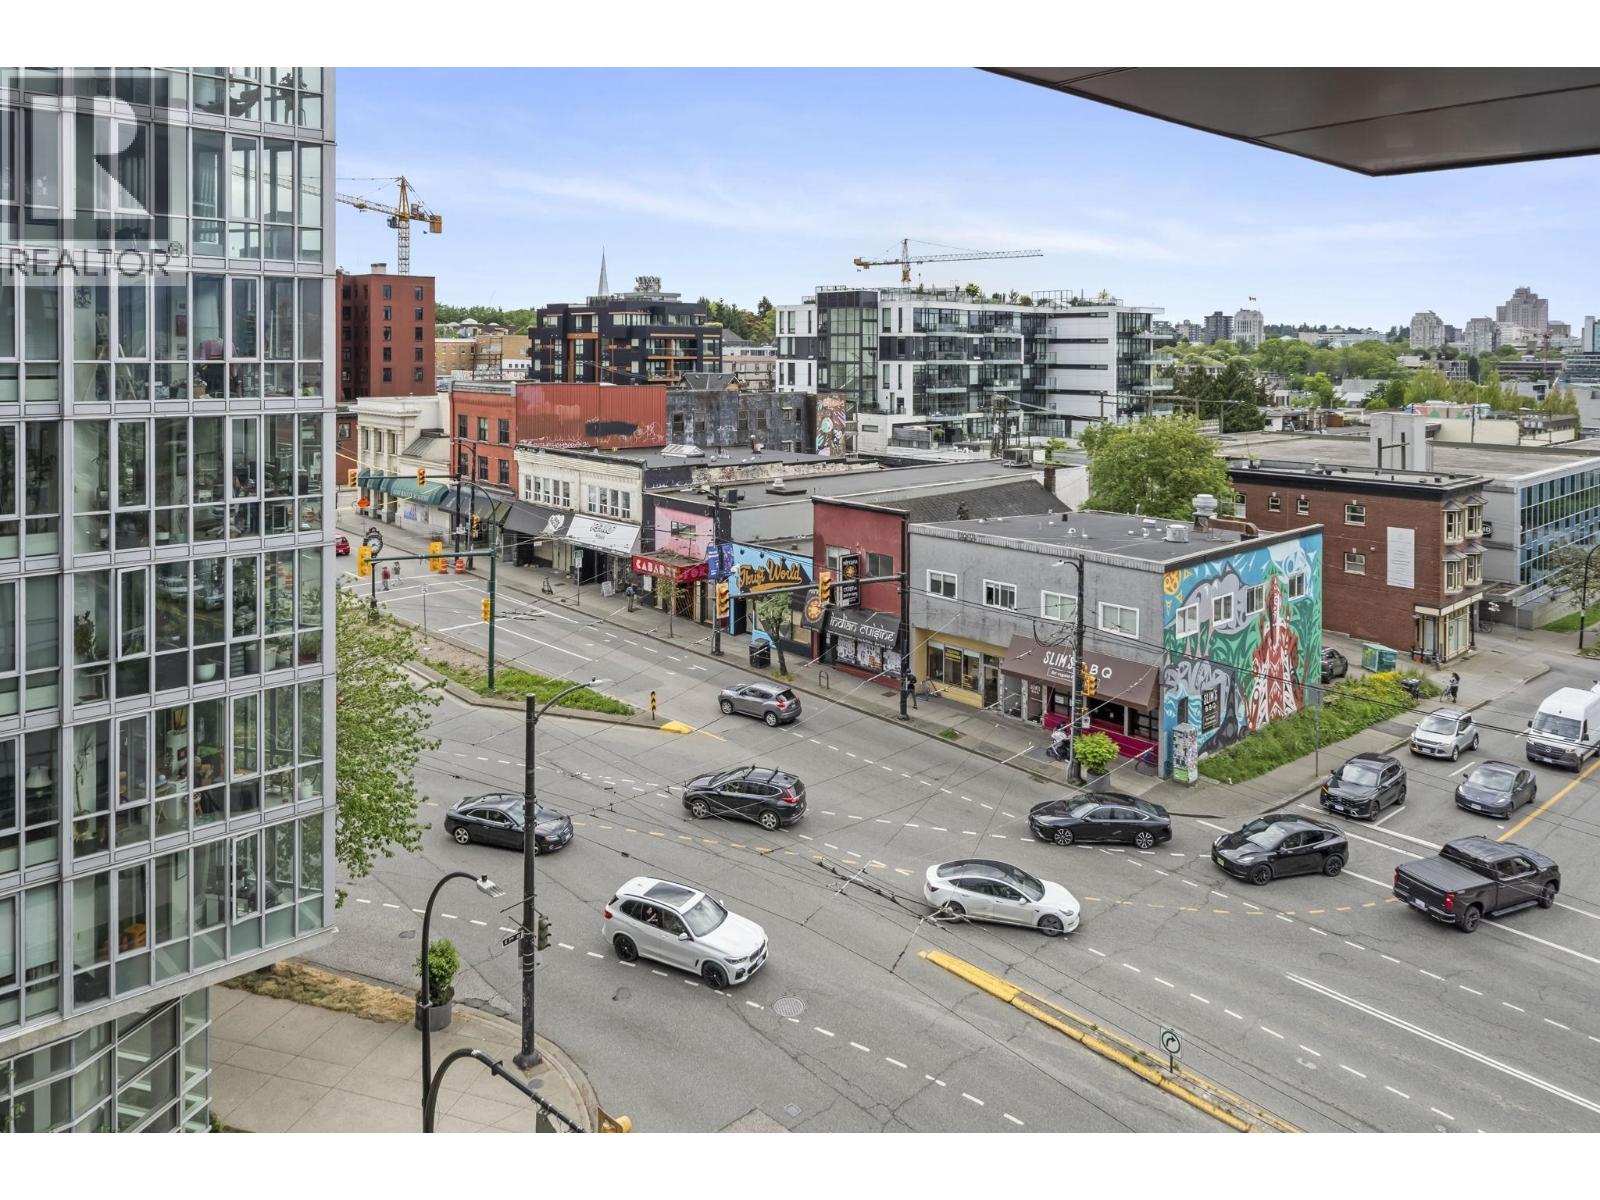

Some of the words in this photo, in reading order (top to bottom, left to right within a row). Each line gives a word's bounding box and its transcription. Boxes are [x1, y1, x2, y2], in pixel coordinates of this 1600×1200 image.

[636, 559, 677, 579] CABAR
[738, 564, 767, 588] Thrift
[767, 558, 802, 582] World
[829, 611, 858, 632] indian
[859, 622, 896, 642] cuisine
[1043, 650, 1074, 670] SLIM'S
